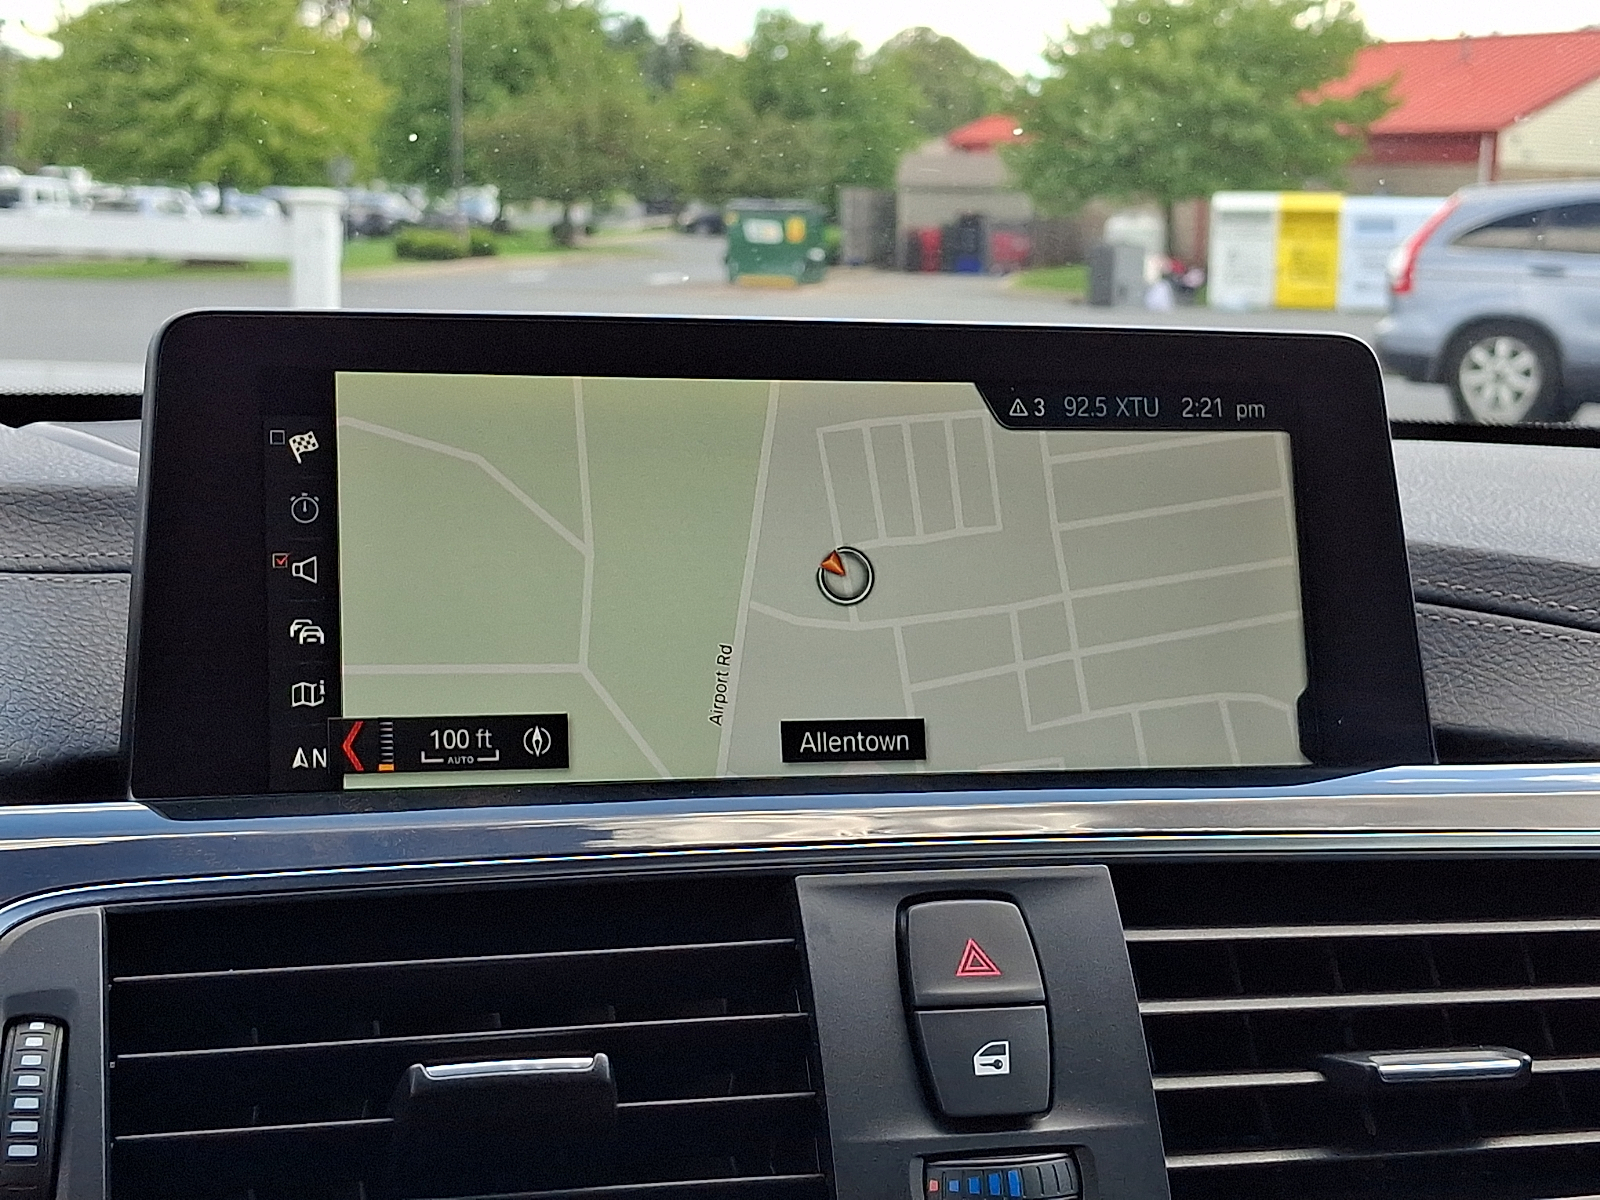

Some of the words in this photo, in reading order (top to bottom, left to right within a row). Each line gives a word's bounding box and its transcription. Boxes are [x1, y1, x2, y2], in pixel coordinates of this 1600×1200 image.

[1034, 398, 1045, 417] 3
[1064, 396, 1107, 418] 92.5
[1116, 397, 1159, 418] XTU
[1181, 397, 1223, 418] 2:21
[1236, 401, 1266, 421] pm
[716, 643, 733, 667] Rd
[708, 670, 730, 727] Airport
[430, 729, 469, 750] 100
[476, 729, 493, 749] ft
[799, 731, 910, 753] Allentown
[312, 748, 327, 768] N
[447, 756, 475, 765] AUTO
